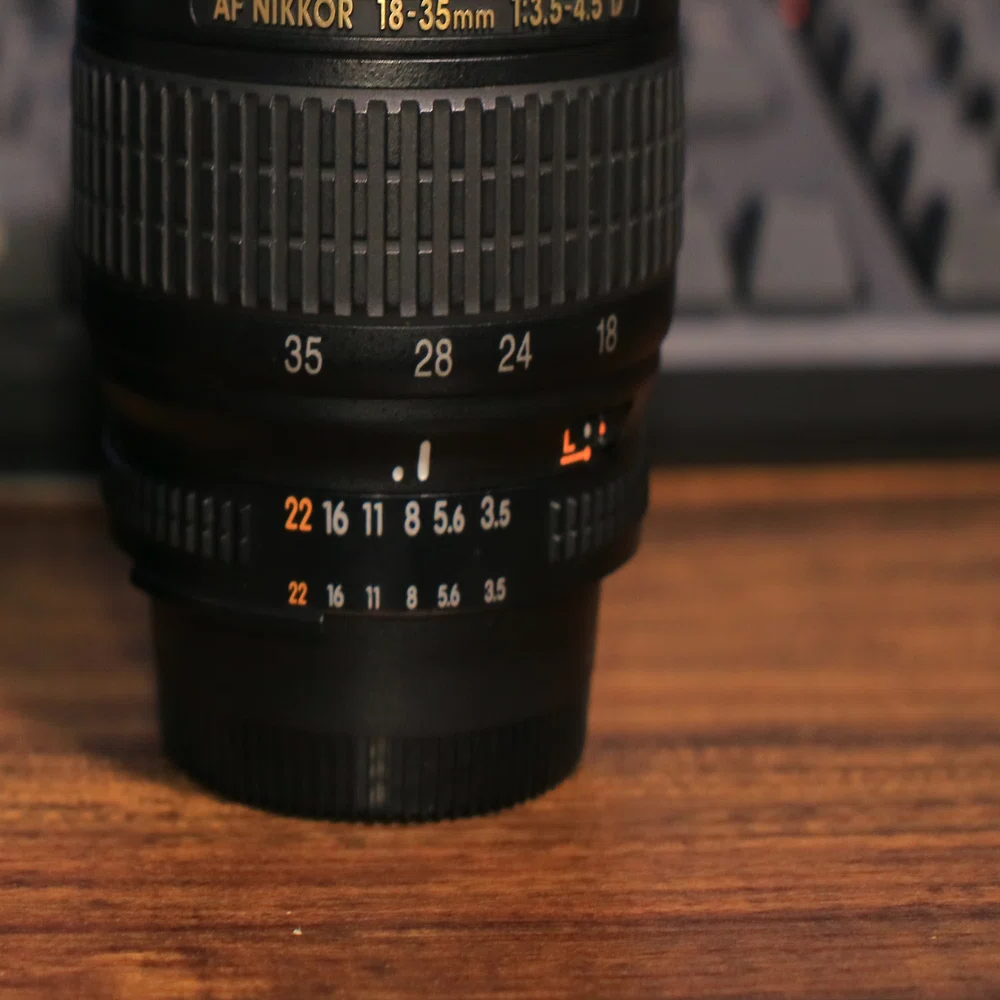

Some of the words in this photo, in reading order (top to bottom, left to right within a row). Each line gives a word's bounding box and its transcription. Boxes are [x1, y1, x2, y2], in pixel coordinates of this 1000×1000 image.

[284, 334, 323, 375] 35
[414, 338, 454, 378] 28
[498, 331, 533, 373] 24
[597, 313, 619, 354] 18
[284, 496, 313, 532] 22
[322, 501, 350, 537] 16
[362, 502, 384, 537] 11
[404, 501, 421, 537] 8
[433, 500, 466, 535] 5.6
[480, 496, 512, 531] 3.5
[288, 581, 308, 606] 22
[326, 584, 345, 609] 16
[366, 586, 381, 611] 11
[406, 585, 419, 610] 8
[437, 583, 461, 609] 5.6
[484, 577, 507, 604] 3.5
